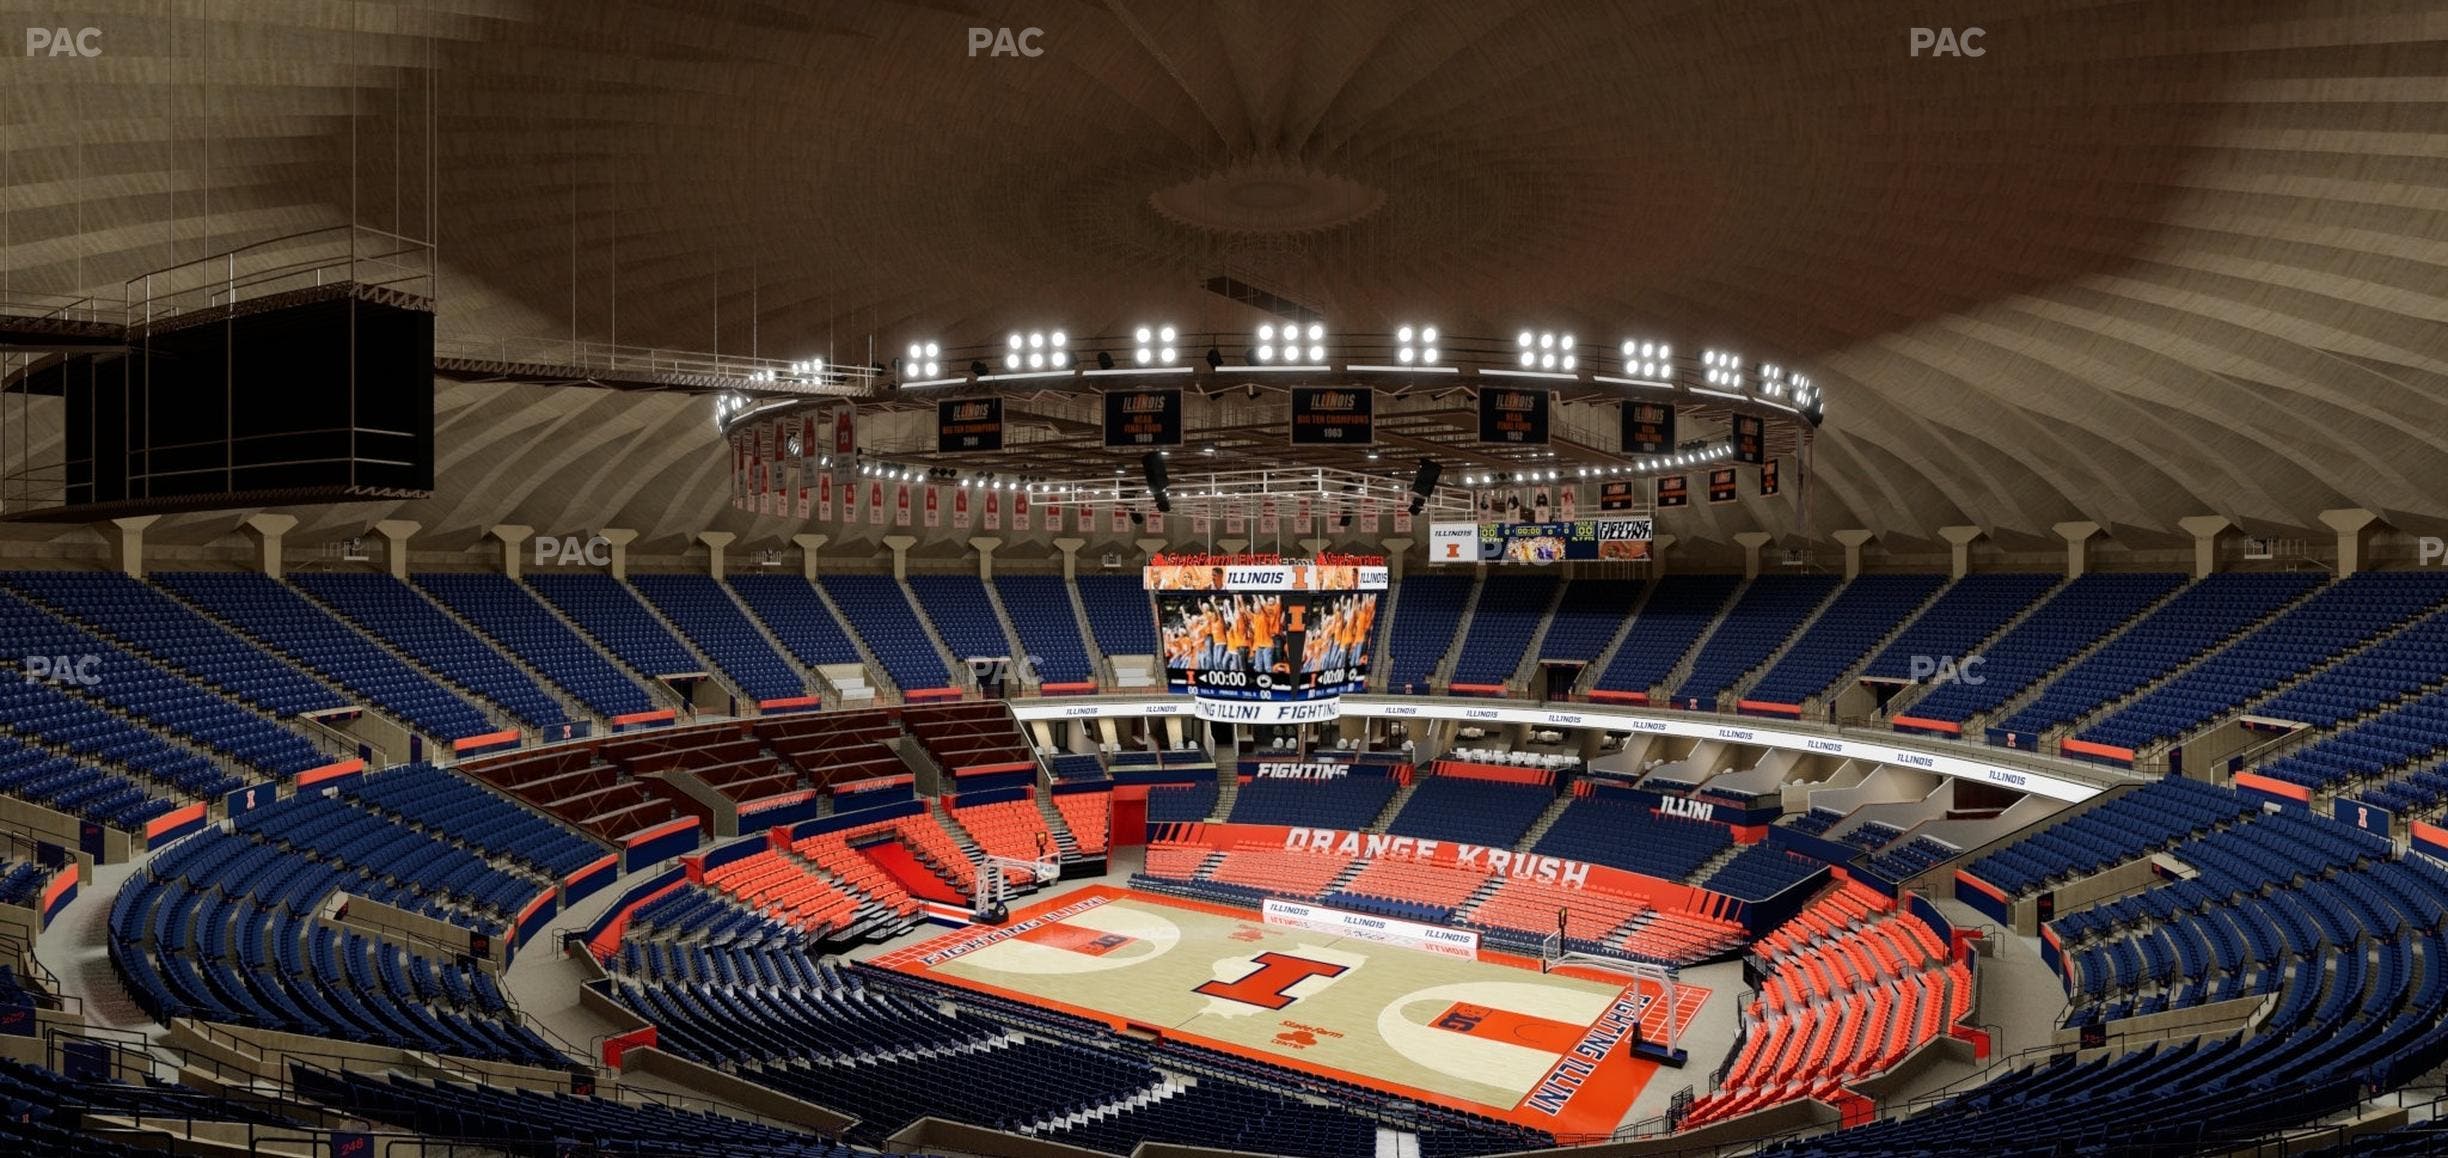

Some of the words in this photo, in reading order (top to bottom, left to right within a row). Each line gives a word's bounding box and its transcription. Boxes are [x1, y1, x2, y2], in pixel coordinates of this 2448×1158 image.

[1434, 529, 1472, 537] ILLINOIS
[1227, 572, 1284, 584] ILLINOIS
[1360, 572, 1388, 584] ILLINOIS
[1208, 671, 1246, 687] 00:00
[1323, 668, 1345, 685] 00:00
[1066, 707, 1098, 715] ILLINOIS
[1145, 705, 1177, 713] ILLINOIS
[1217, 704, 1261, 719] ILLINI
[1385, 707, 1417, 715] ILLINOIS
[1466, 710, 1499, 719] ILLINOIS
[1548, 715, 1582, 724] ILLINOIS
[1633, 720, 1667, 731] ILLINOIS
[1718, 729, 1754, 740] ILLINOIS
[1807, 740, 1843, 752] ILLINOIS
[1897, 753, 1934, 768] ILLINOIS
[1257, 763, 1350, 780] FIGHTING
[1988, 770, 2026, 786] ILLINOIS
[1660, 795, 1714, 822] ILLINI
[1284, 827, 1439, 859] ORANGE
[1456, 844, 1591, 890] KRUSH
[1270, 903, 1310, 916] ILLINOIS
[1343, 916, 1386, 929] ILLINOIS
[920, 918, 1043, 967] FIGHTING
[1424, 929, 1471, 943] ILLINOIS
[1572, 990, 1652, 1062] FIGHTING
[1523, 1056, 1597, 1117] ILLINI
